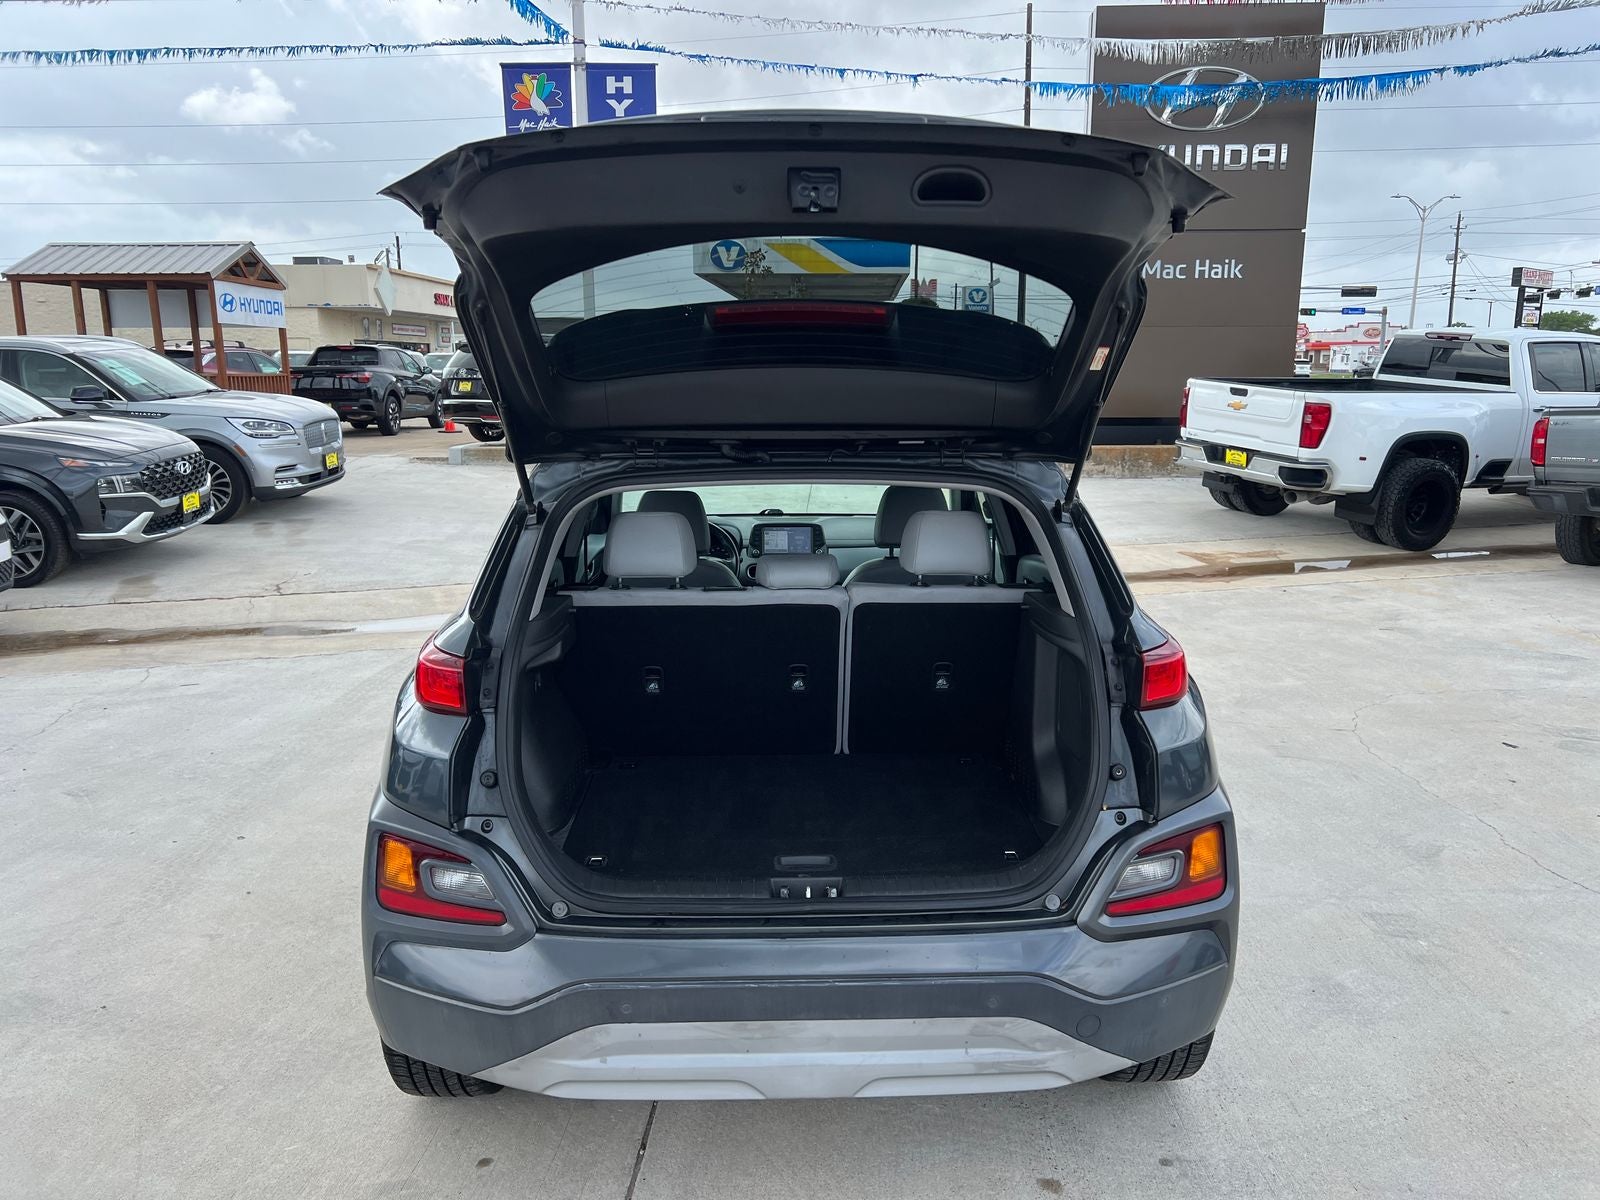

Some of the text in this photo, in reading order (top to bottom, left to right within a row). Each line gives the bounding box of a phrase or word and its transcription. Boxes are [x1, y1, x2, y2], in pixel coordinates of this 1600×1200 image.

[1141, 258, 1244, 280] Mac Haik
[238, 296, 284, 317] HYUNDAI
